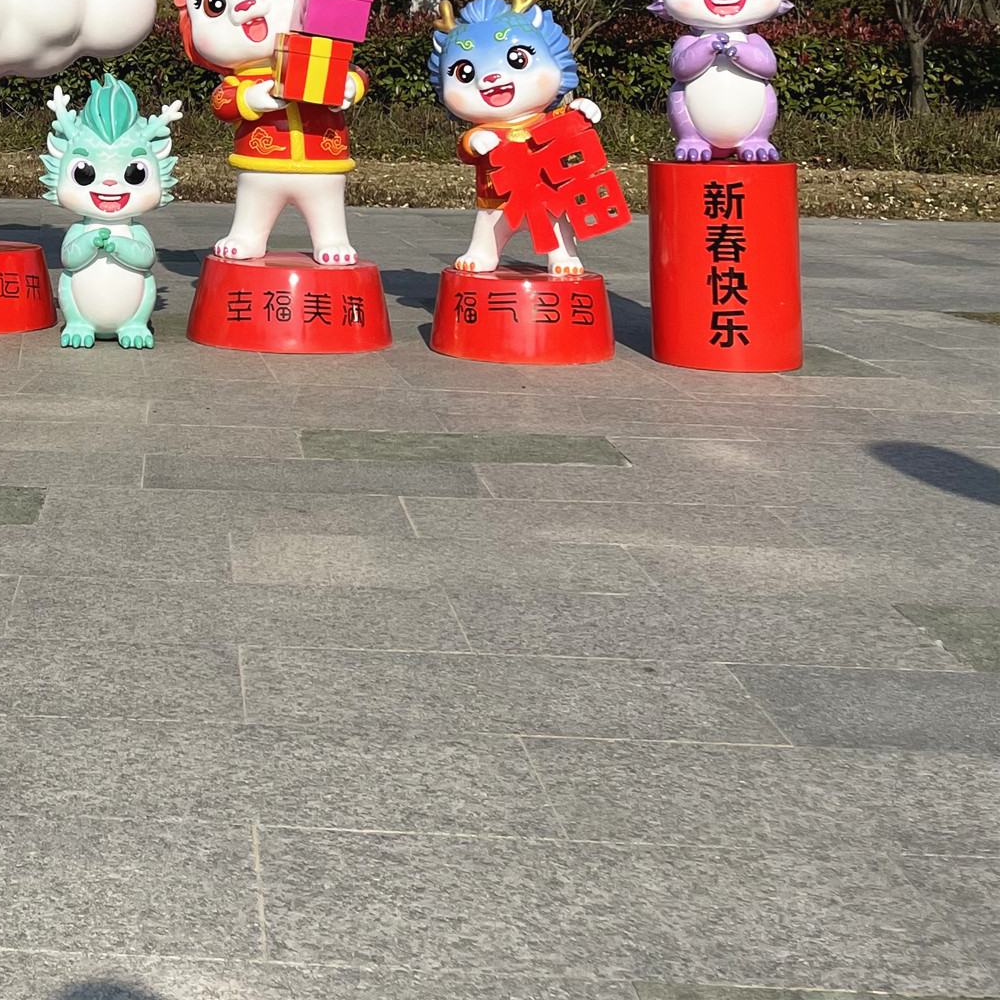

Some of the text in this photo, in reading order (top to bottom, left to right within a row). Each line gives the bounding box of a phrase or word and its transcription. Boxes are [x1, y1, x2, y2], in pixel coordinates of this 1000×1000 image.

[489, 110, 632, 255] 福
[227, 290, 365, 327] 幸福美满
[454, 291, 595, 326] 福气多多
[703, 181, 750, 348] 新春快乐
